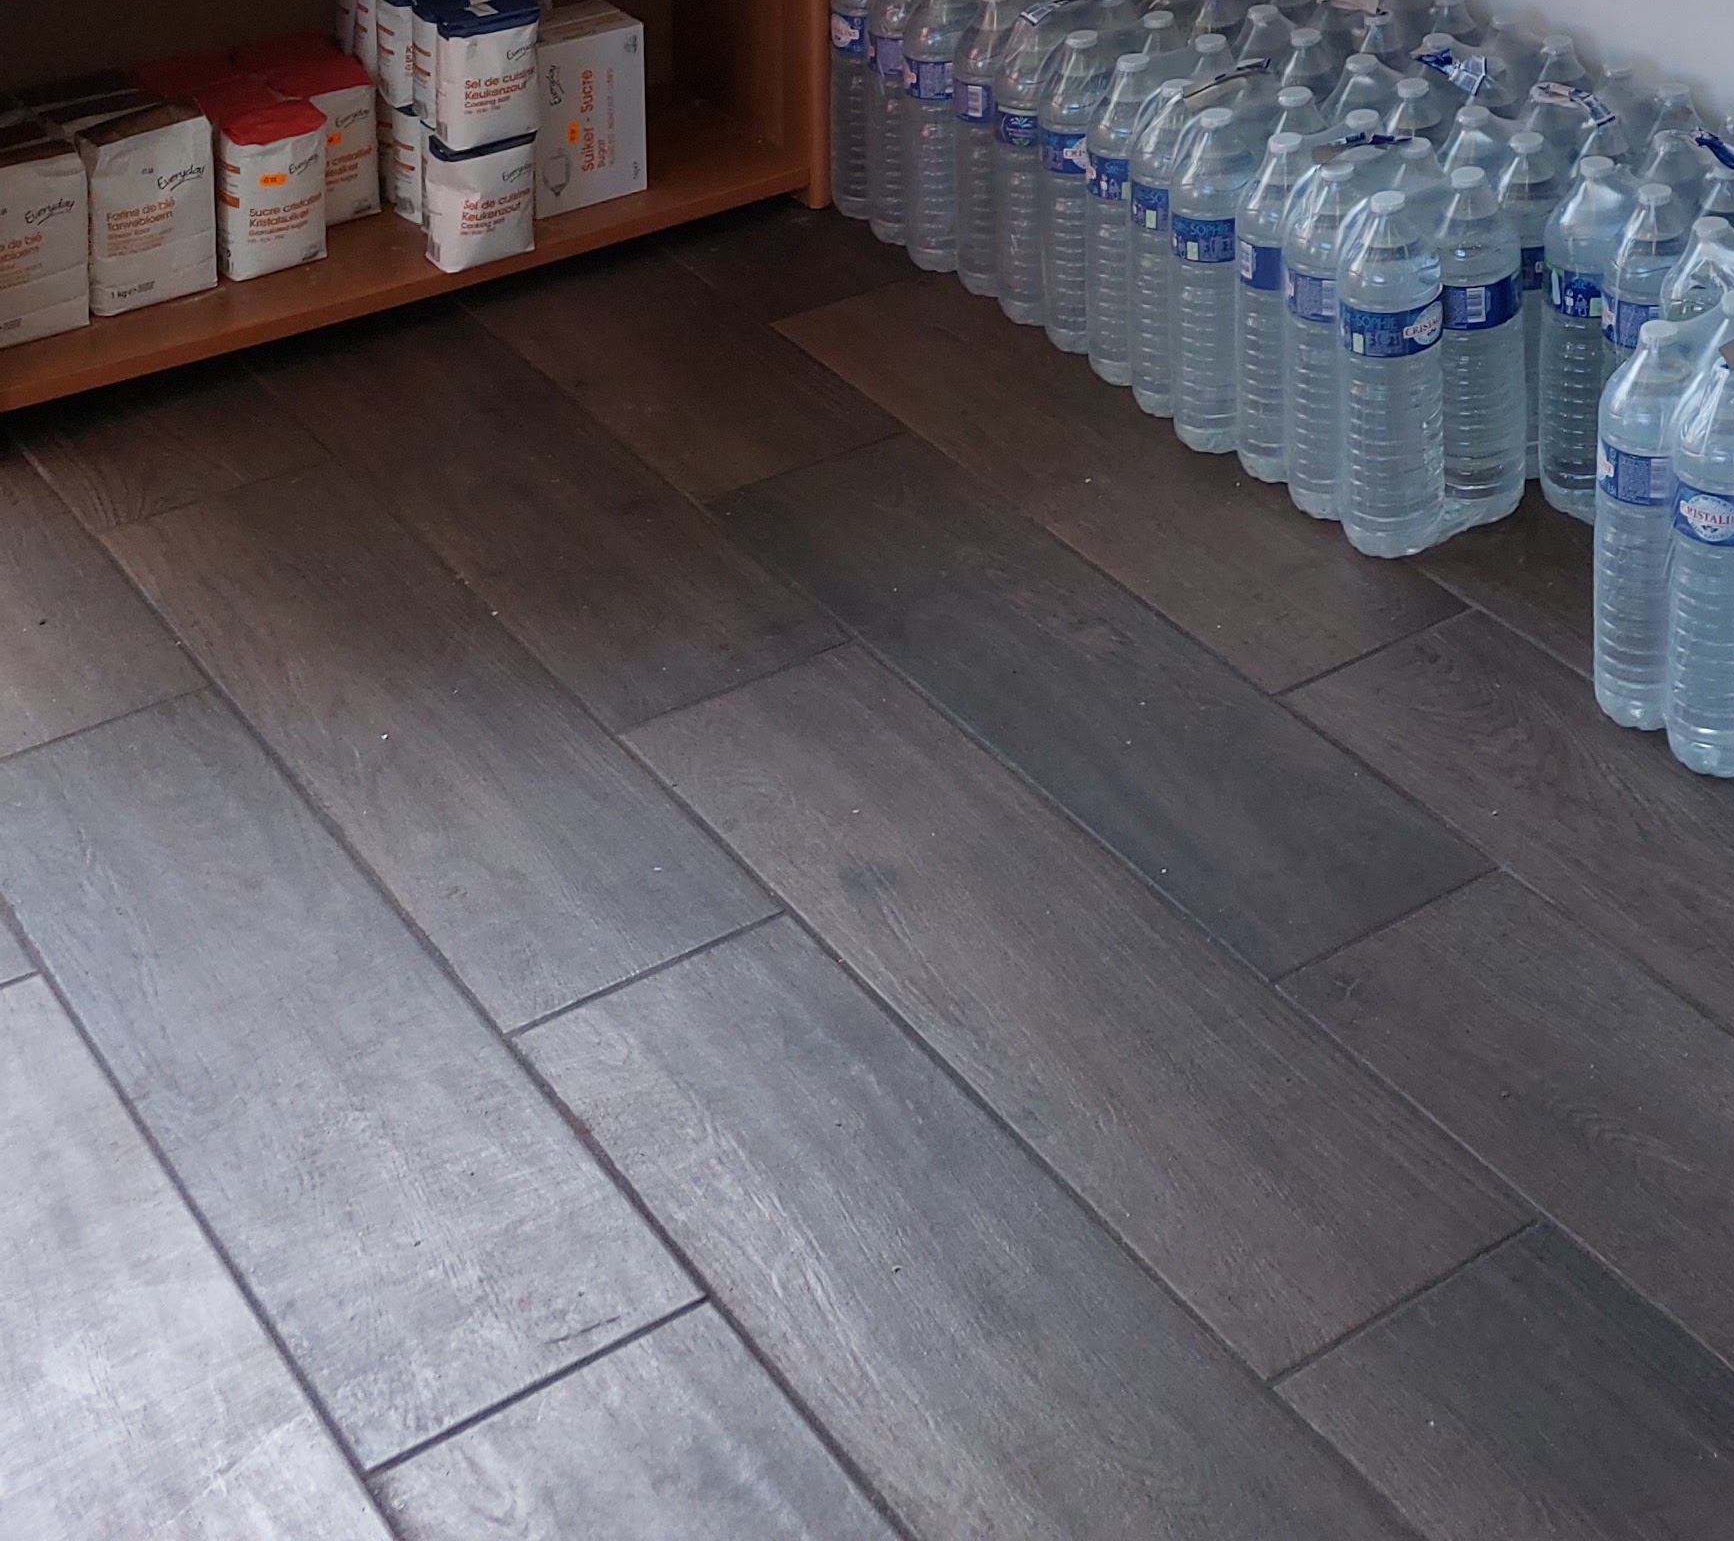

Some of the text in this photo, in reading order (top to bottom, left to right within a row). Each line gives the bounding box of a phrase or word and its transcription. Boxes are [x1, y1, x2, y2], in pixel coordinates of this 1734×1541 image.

[465, 80, 481, 90] Sel
[485, 77, 499, 88] de
[581, 69, 594, 173] Suiker Sucre
[157, 166, 205, 190] Everyday
